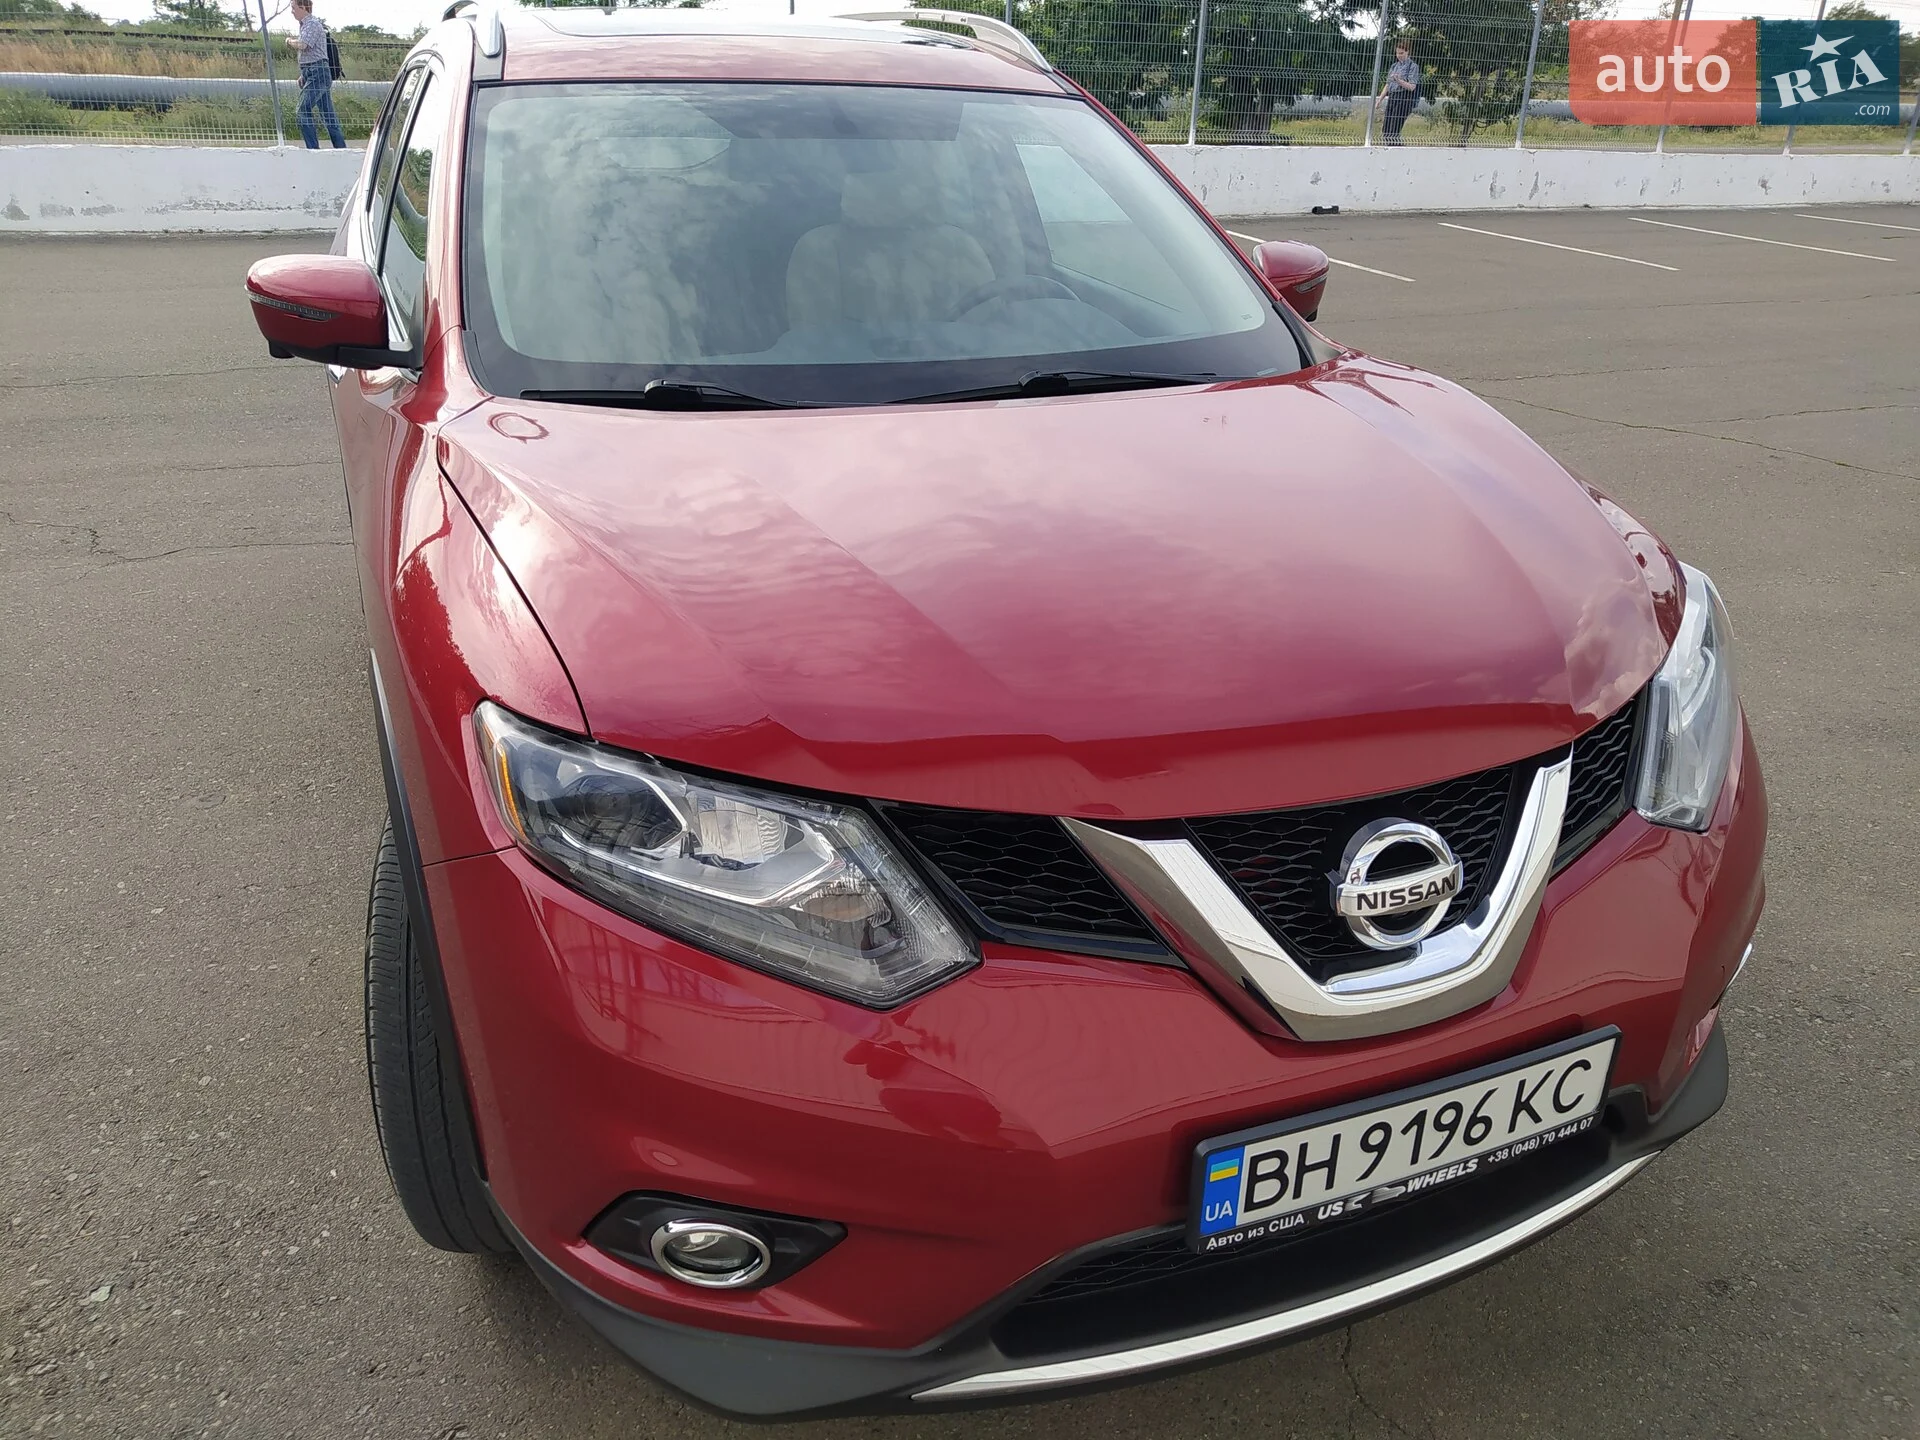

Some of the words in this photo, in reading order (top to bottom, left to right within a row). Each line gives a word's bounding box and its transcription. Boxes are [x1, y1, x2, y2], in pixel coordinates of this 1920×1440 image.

[1356, 873, 1456, 911] NISSAN
[1243, 1133, 1341, 1213] BH
[1355, 1087, 1498, 1182] 9196
[1507, 1059, 1592, 1134] KC
[1487, 1148, 1509, 1164] +38
[1511, 1137, 1540, 1158] (048)
[1542, 1131, 1556, 1146] 70
[1557, 1123, 1578, 1139] 444
[1579, 1116, 1594, 1131] 07
[1406, 1158, 1479, 1194] WHEELS
[1205, 1200, 1233, 1222] UA
[1248, 1226, 1265, 1239] из
[1268, 1213, 1305, 1233] США
